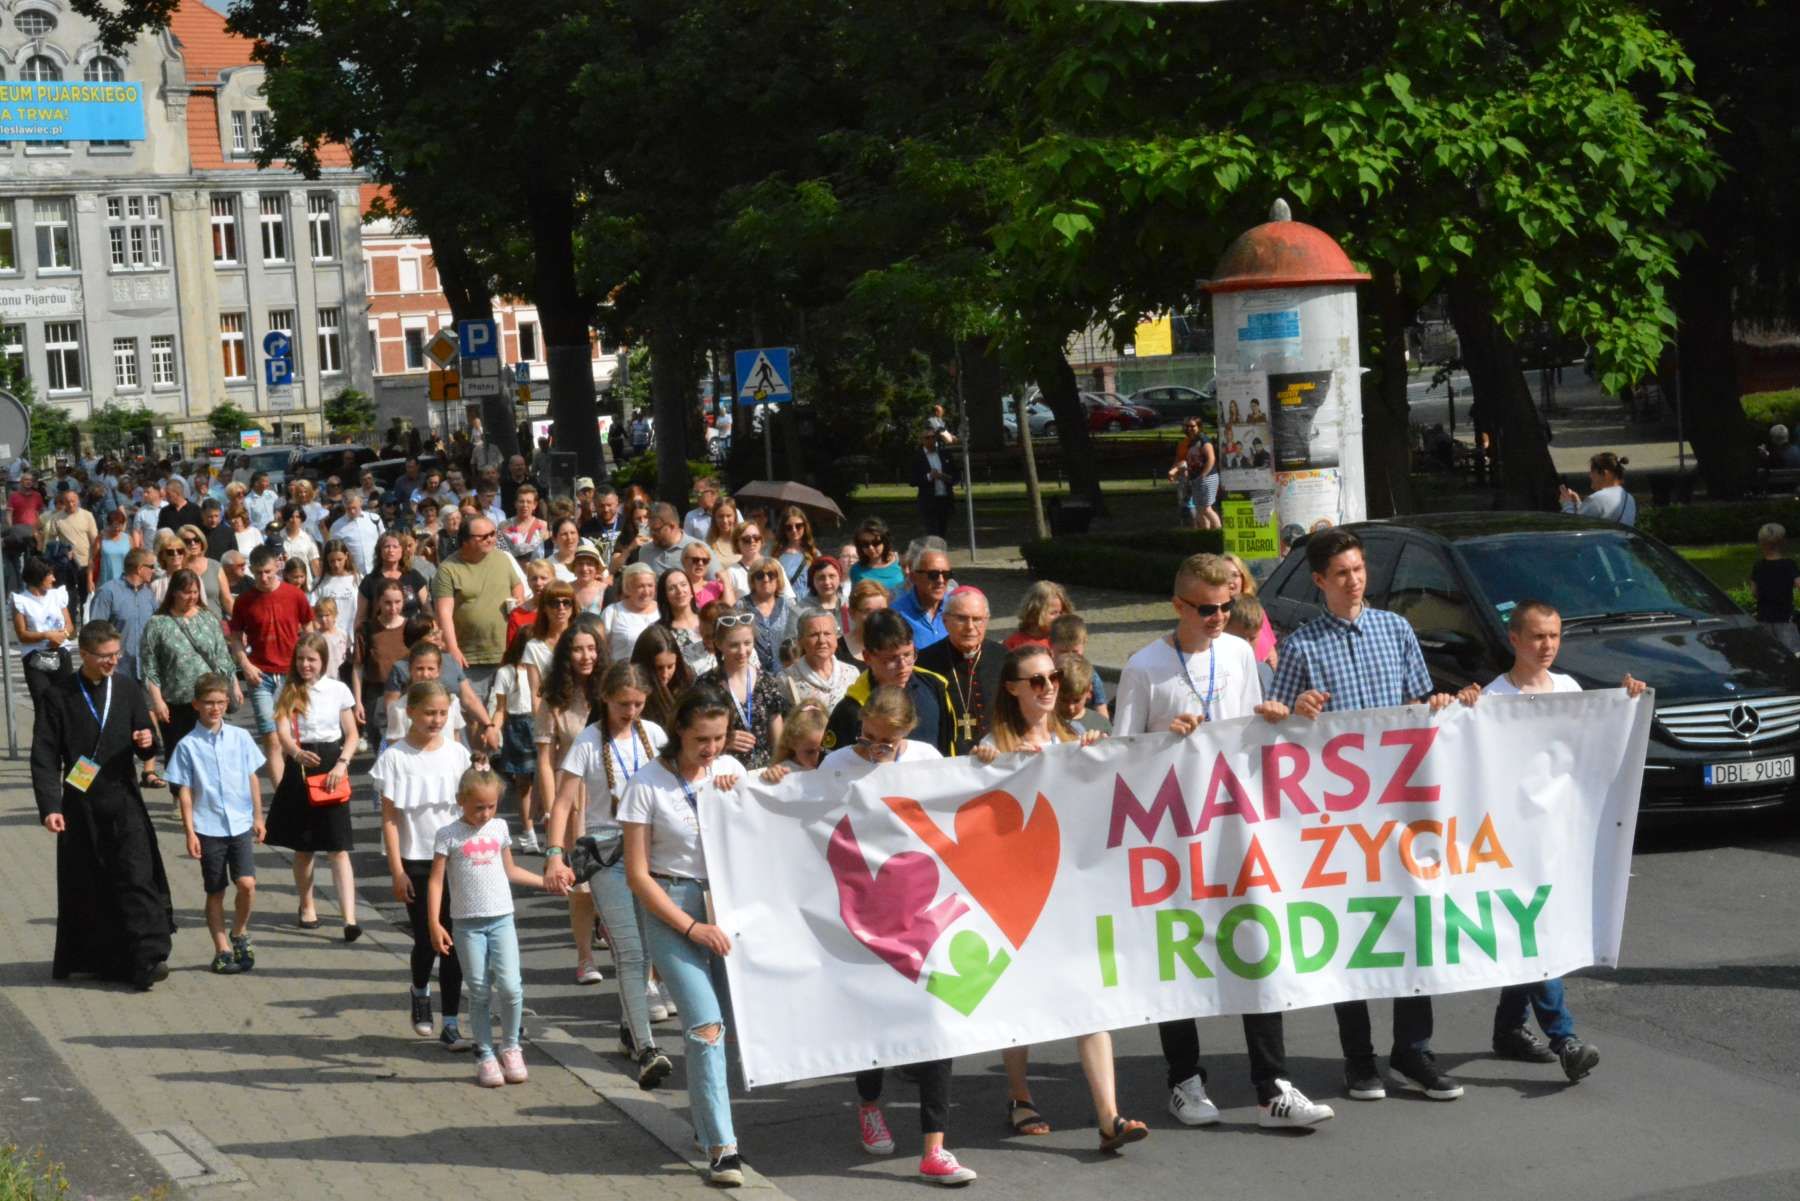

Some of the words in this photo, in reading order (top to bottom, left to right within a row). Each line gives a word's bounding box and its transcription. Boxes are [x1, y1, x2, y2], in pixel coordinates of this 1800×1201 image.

[37, 86, 137, 102] PIJARSKIEGO
[18, 108, 69, 121] TRWA!
[25, 294, 66, 306] Pijarów
[468, 324, 489, 353] P
[271, 361, 286, 382] P
[1716, 765, 1748, 784] DBL
[1755, 759, 1791, 781] 9U30
[1106, 727, 1441, 849] MARSZ
[1127, 832, 1281, 907] DLA
[1300, 812, 1514, 889] ŻYCIA
[1095, 914, 1118, 988] I
[1155, 884, 1553, 982] RODZINY
